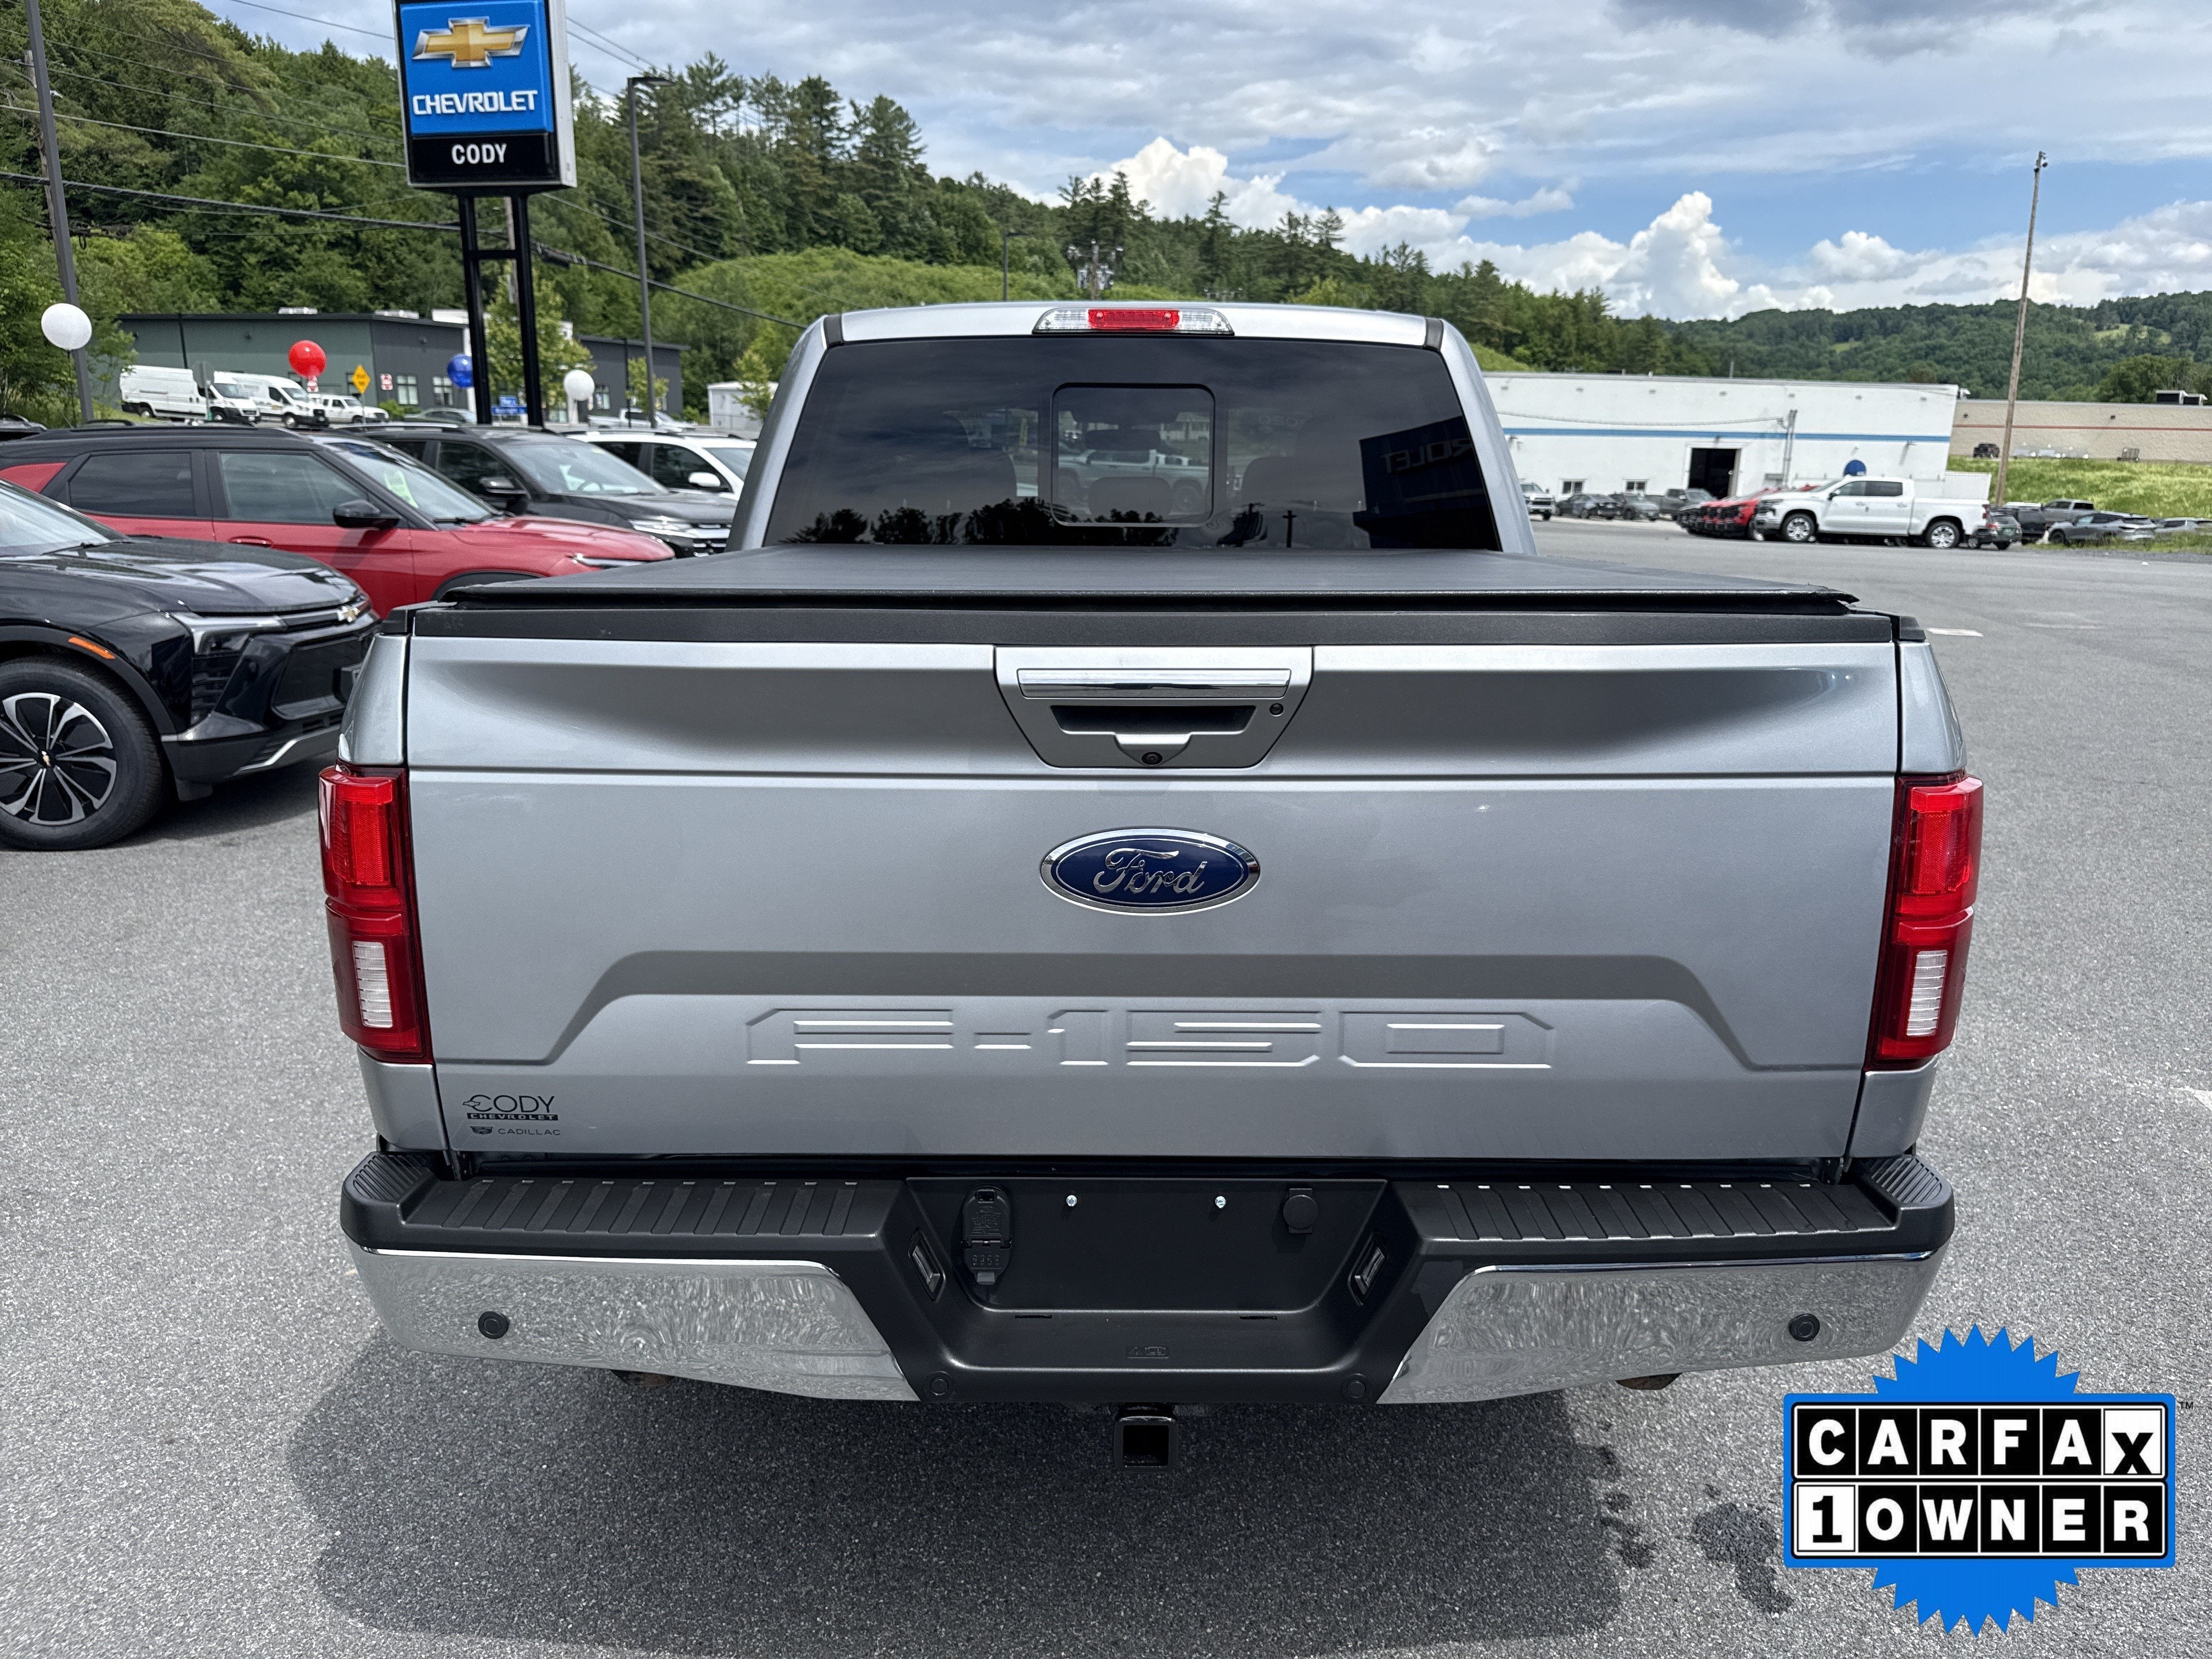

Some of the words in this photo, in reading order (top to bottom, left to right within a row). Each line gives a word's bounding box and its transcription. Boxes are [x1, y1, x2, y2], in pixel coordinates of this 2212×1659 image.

[413, 90, 538, 115] CHEVROLET
[452, 143, 507, 165] CODY
[1093, 848, 1208, 894] Ford
[746, 1008, 1552, 1069] F-150
[463, 1094, 555, 1113] CODY
